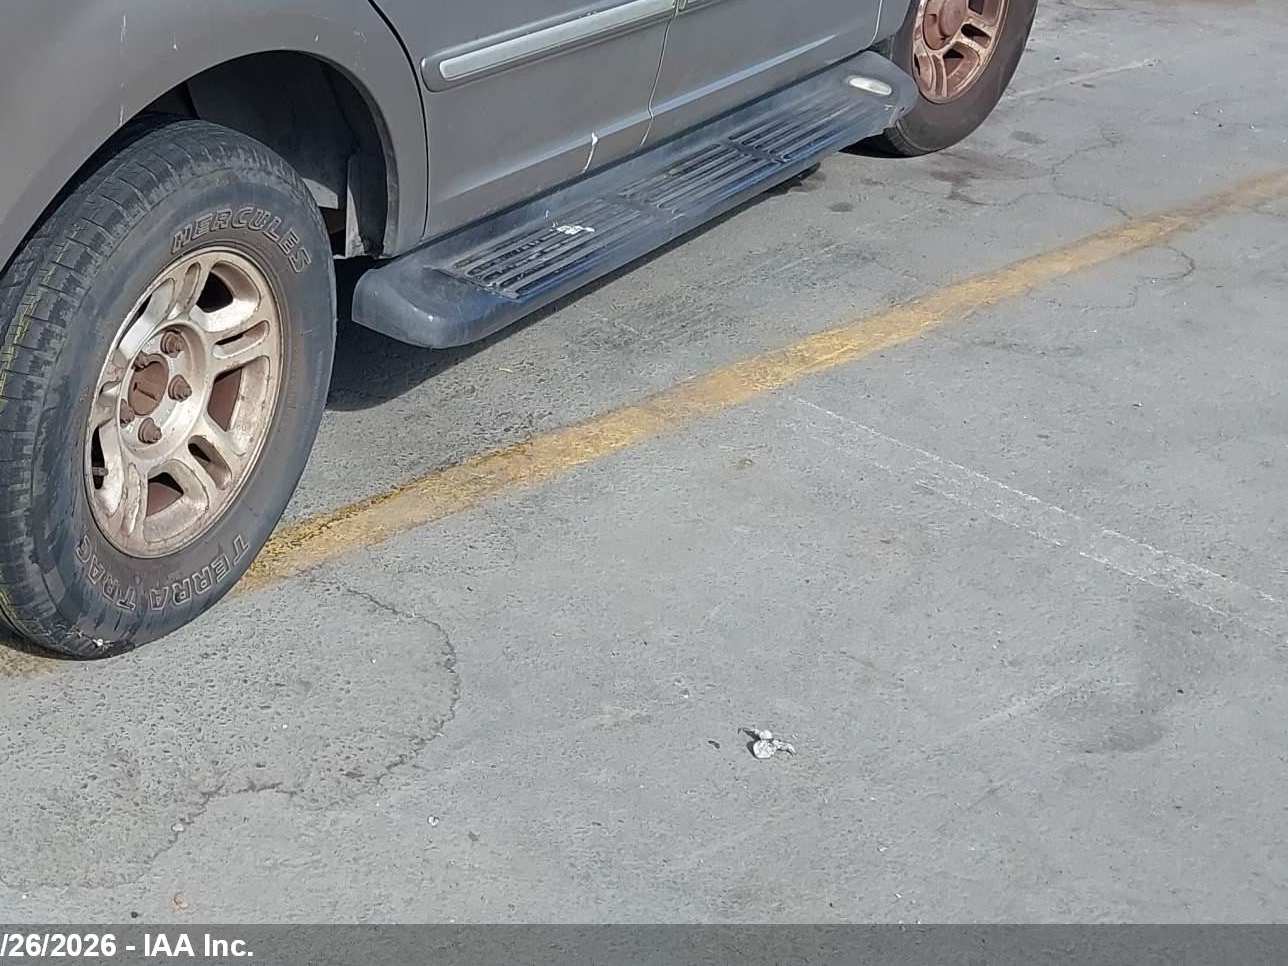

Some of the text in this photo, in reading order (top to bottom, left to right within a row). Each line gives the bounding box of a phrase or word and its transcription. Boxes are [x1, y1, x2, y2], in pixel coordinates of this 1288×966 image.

[171, 206, 312, 273] HERCULES
[75, 534, 250, 611] TERRA TRAC
